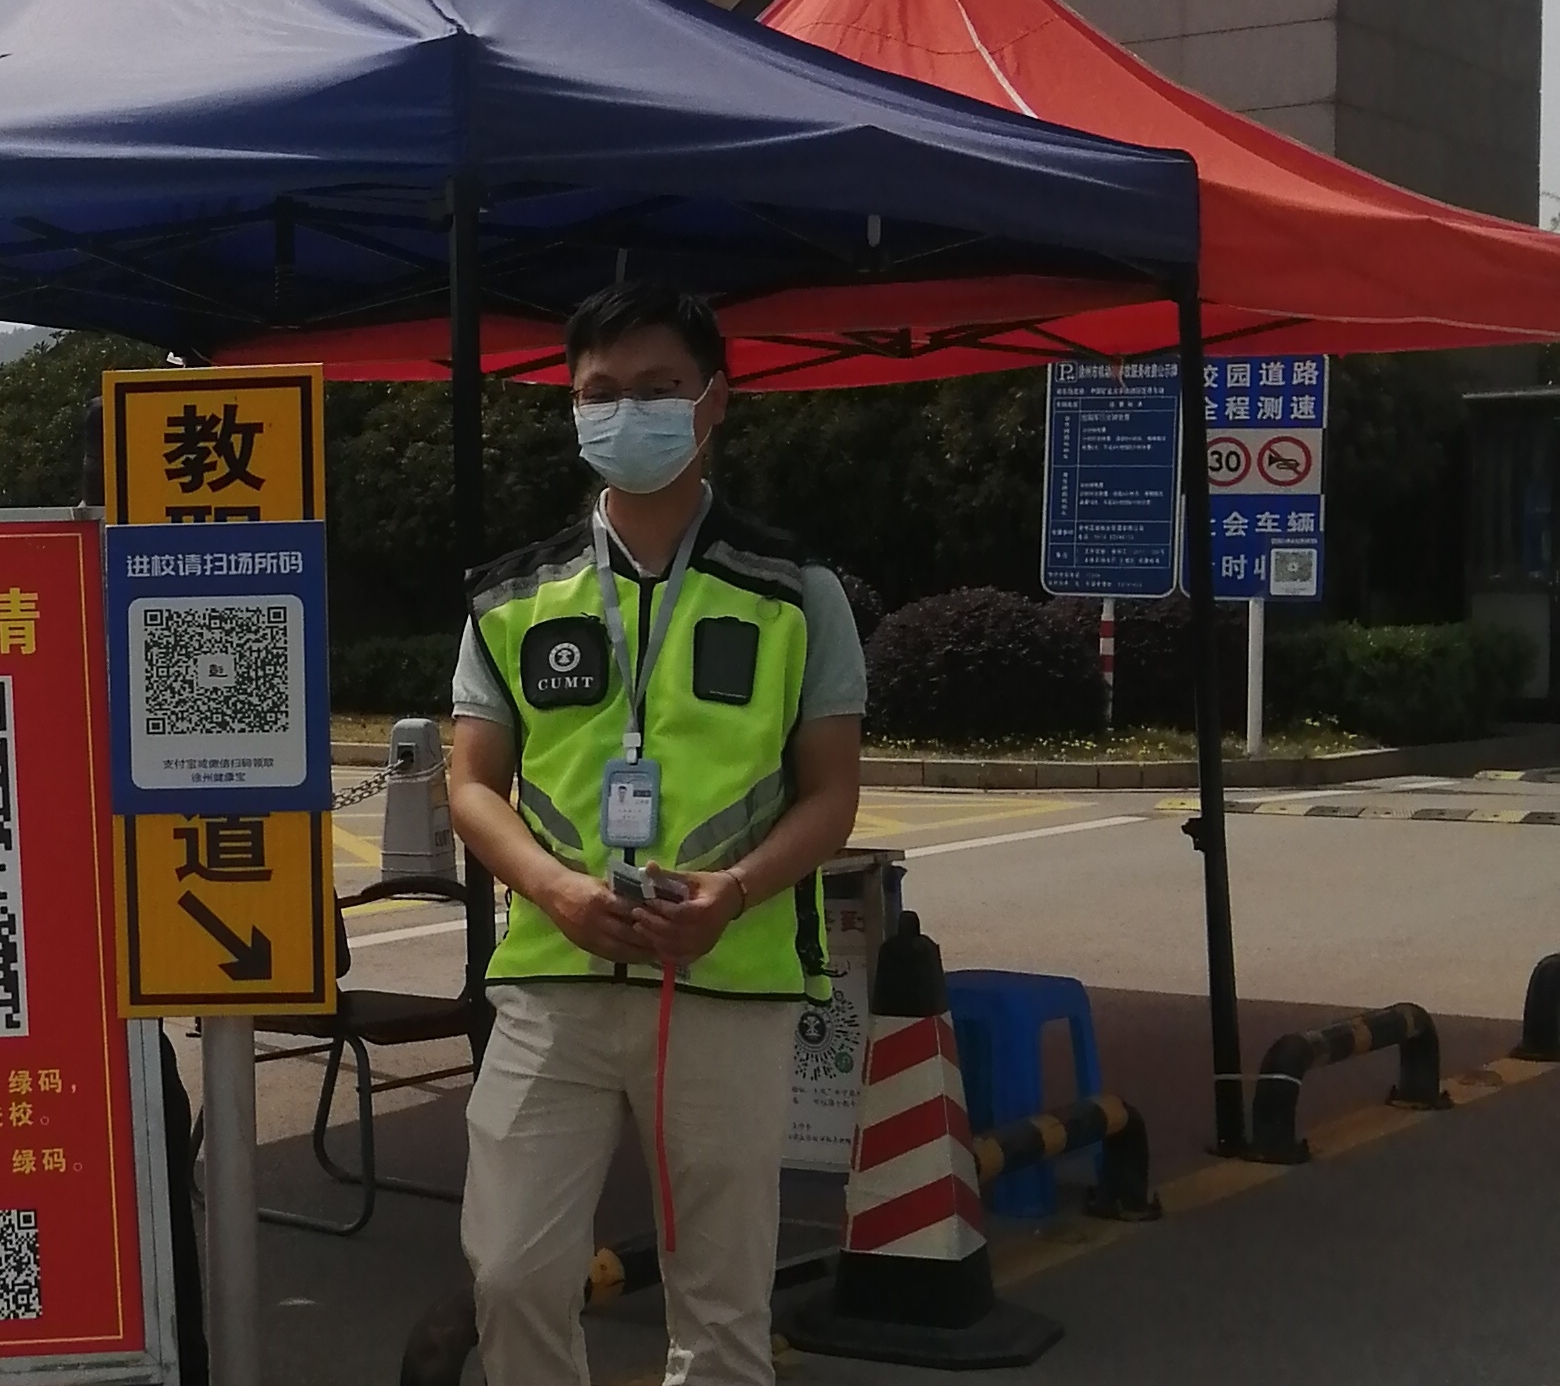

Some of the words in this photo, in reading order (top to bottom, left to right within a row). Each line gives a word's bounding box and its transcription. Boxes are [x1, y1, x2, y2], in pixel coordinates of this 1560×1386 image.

[162, 404, 266, 522] 教
[1208, 450, 1241, 472] 30
[1210, 510, 1316, 536] 会车辆
[127, 551, 303, 577] 进校请扫场所码
[537, 676, 594, 691] CUMT
